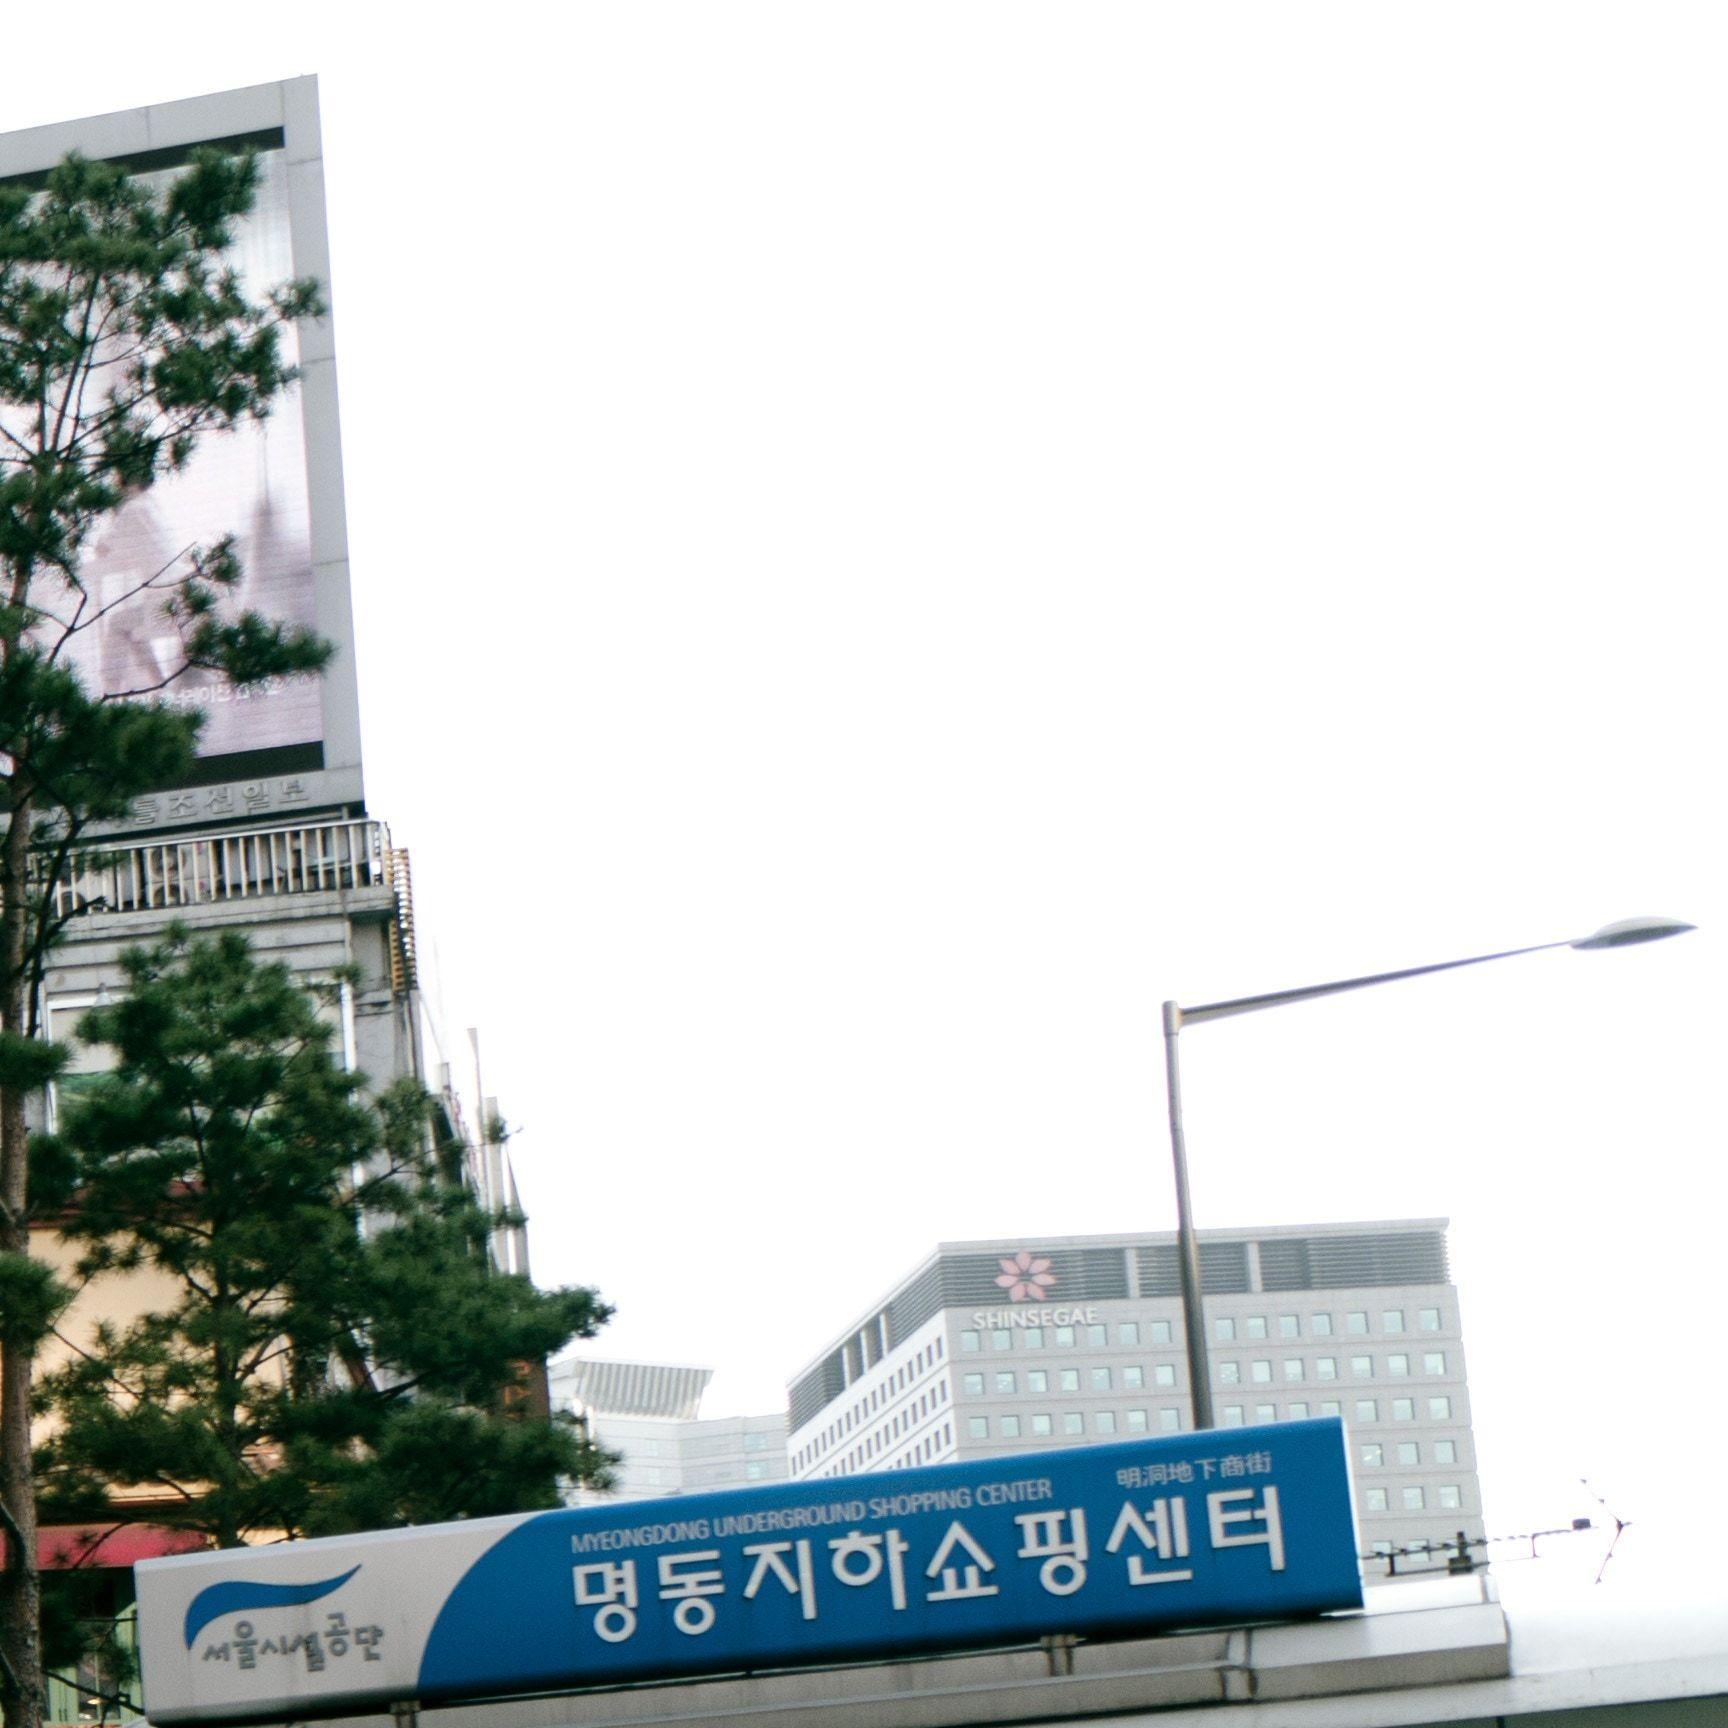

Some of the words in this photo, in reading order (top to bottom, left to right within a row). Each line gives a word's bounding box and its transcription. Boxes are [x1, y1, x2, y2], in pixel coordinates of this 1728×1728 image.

[972, 1306, 1099, 1330] SHINSEGAE
[1116, 1452, 1273, 1489] 明洞地下商街
[571, 1518, 710, 1554] MYEONGDONG
[714, 1503, 867, 1538] UNDERGROUND
[870, 1489, 972, 1521] SHOPPING
[976, 1479, 1053, 1508] CENTER
[571, 1485, 1287, 1644] 명동지하쇼핑센터
[202, 1612, 385, 1672] 서울시설공단
